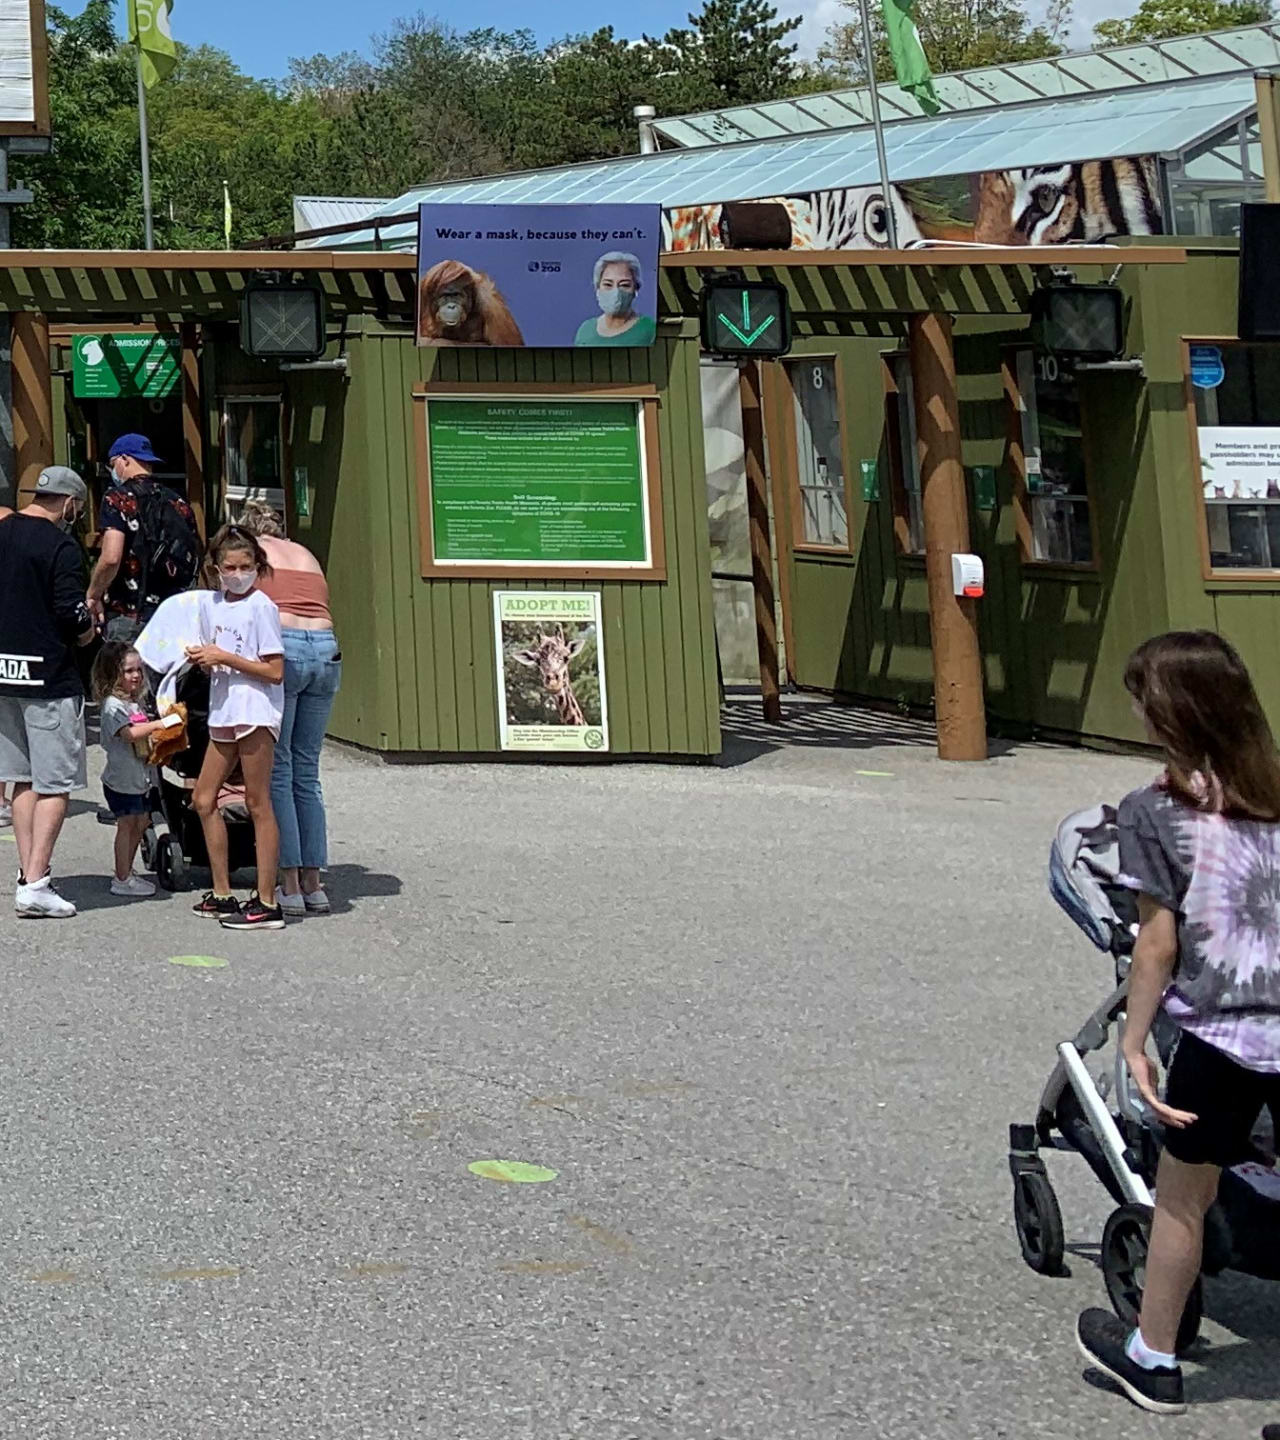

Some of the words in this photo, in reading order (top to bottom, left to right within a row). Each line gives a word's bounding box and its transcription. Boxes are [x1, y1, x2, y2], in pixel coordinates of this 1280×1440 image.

[436, 228, 471, 239] Wear
[475, 231, 482, 239] a
[486, 229, 523, 241] mask,
[527, 229, 577, 240] because
[581, 230, 608, 242] they
[612, 227, 647, 239] can't.
[812, 367, 823, 389] 8
[1040, 359, 1059, 381] 10
[506, 599, 557, 610] ADOPT
[562, 599, 590, 610] ME!
